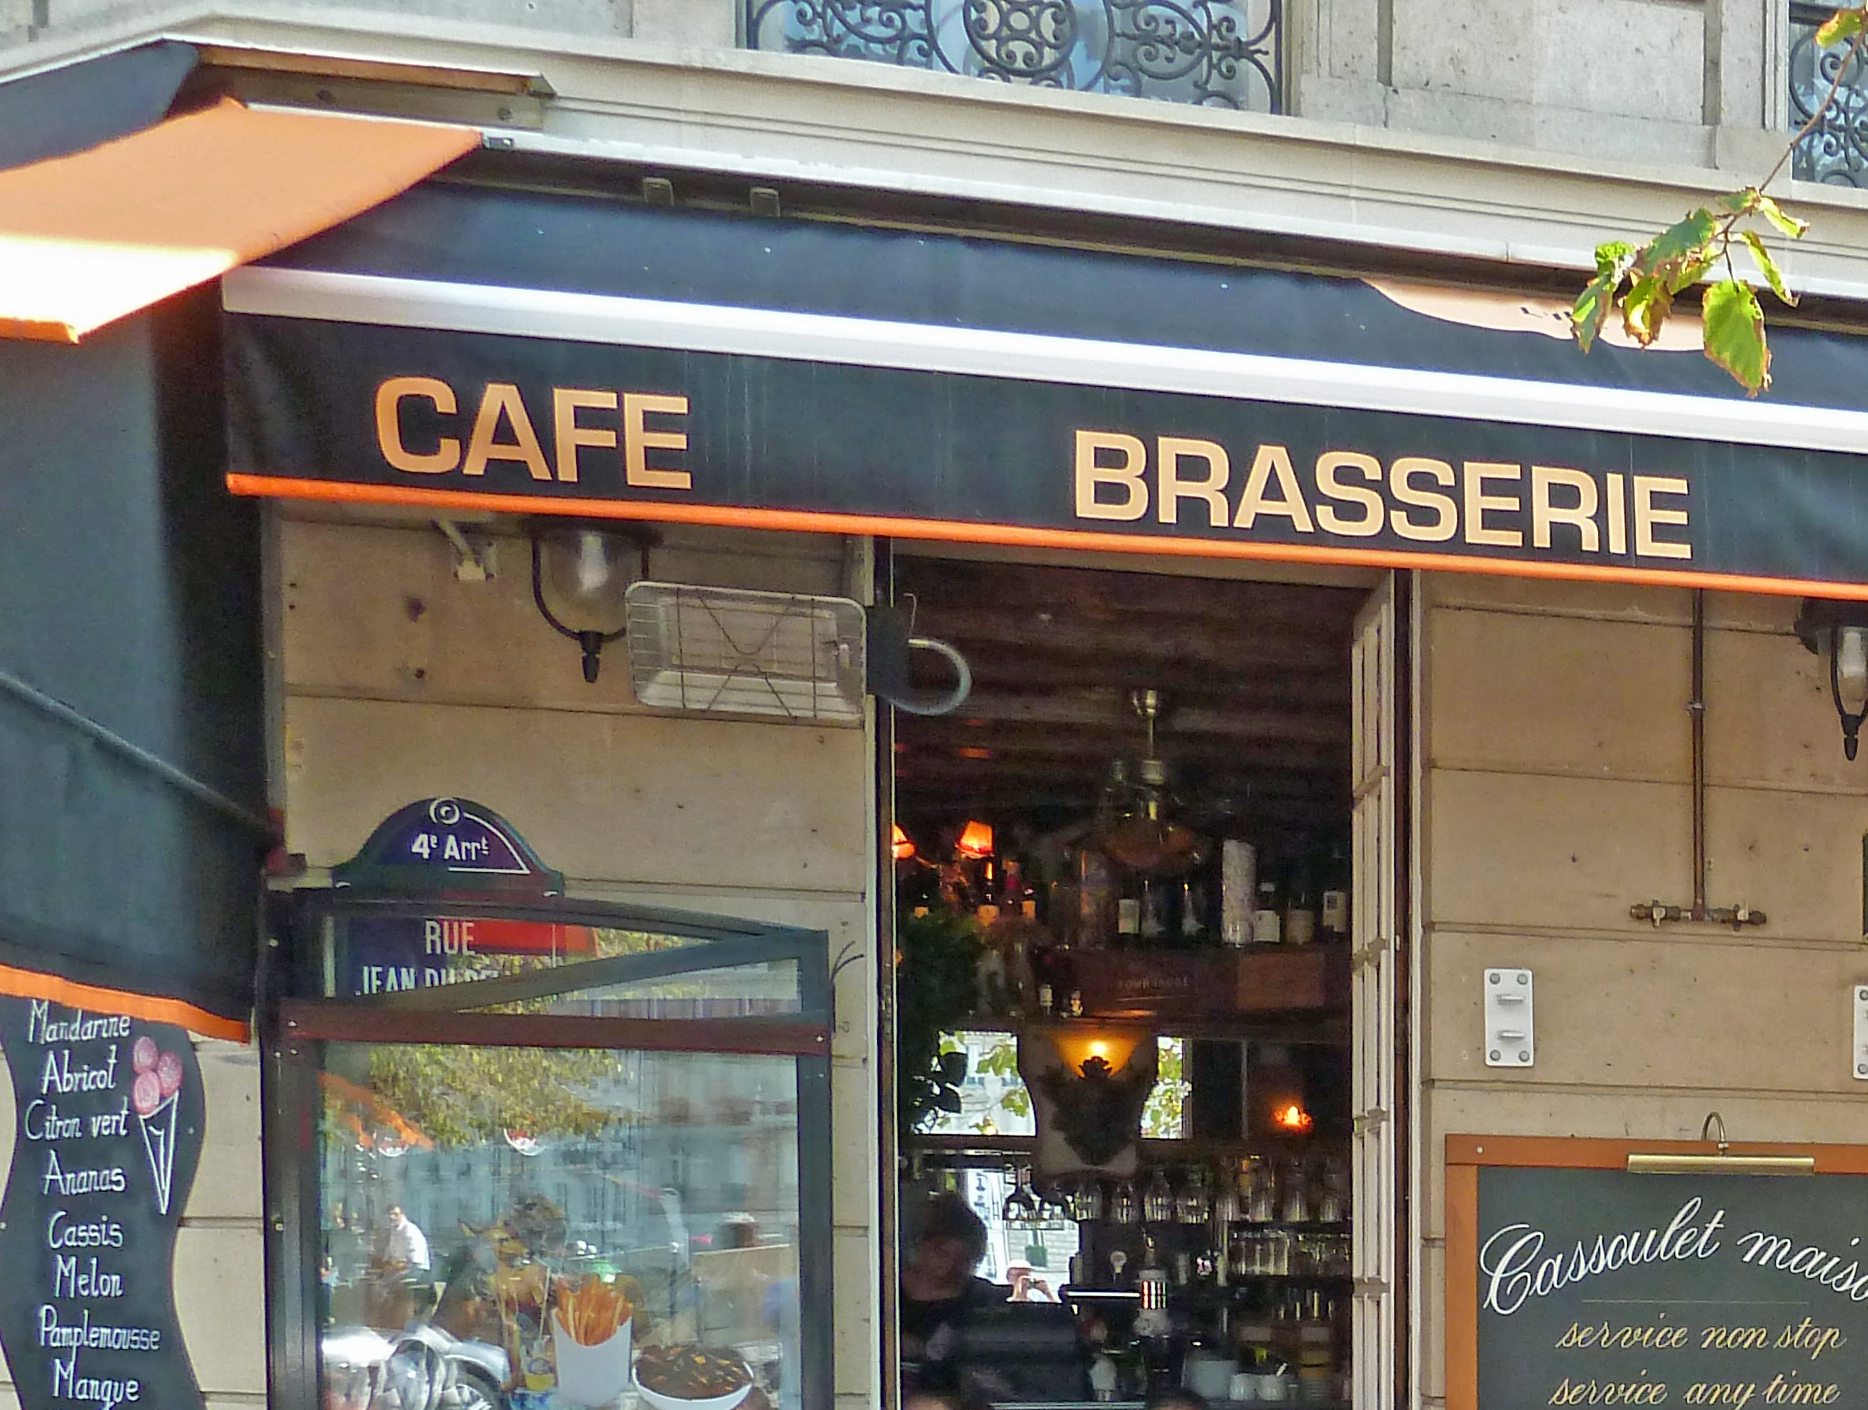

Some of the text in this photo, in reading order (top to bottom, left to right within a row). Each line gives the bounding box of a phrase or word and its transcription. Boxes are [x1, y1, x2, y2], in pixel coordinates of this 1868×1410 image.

[374, 376, 693, 490] CAFE
[1074, 428, 1692, 560] BRASSERIE
[425, 920, 476, 956] RUE
[355, 965, 415, 995] JEAN
[27, 998, 131, 1045] Mandarine
[41, 1047, 118, 1095] Abricot
[25, 1100, 128, 1141] Citron vert
[42, 1150, 126, 1196] Ananas
[48, 1210, 124, 1250] Cassis
[53, 1255, 123, 1300] Melon
[1480, 1196, 1725, 1315] Cassoulet
[38, 1305, 161, 1368] Pamplemousse
[1555, 1312, 1846, 1361] service non stop
[1548, 1368, 1669, 1406] service
[1761, 1368, 1842, 1405] time
